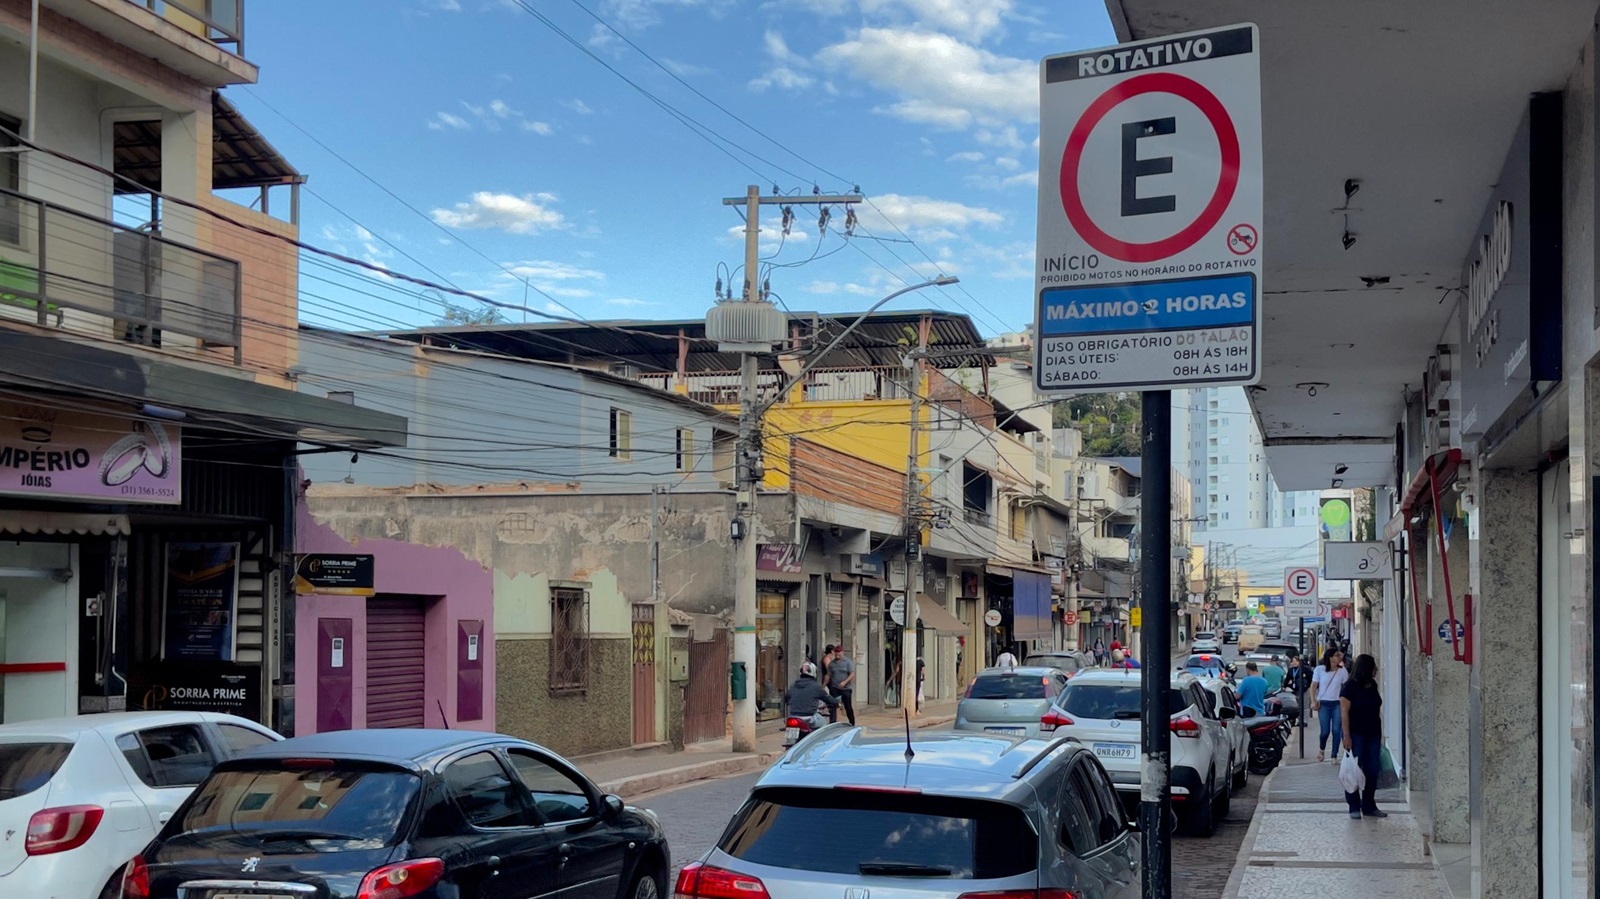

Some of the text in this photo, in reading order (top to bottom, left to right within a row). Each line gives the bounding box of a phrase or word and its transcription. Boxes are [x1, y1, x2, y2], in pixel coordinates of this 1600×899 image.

[1078, 37, 1213, 77] ROTATIVO
[1120, 116, 1177, 217] E
[1040, 258, 1257, 283] PROIBIDO MOTOS NO HORÁRIO DO ROTATIVO
[1044, 254, 1099, 272] INÍCIO
[1046, 291, 1247, 320] MÁXIMO 2 HORAS
[1047, 341, 1074, 353] USO
[1078, 335, 1172, 351] OBRIGATÓRIO
[1200, 328, 1248, 345] TALÃO
[1045, 355, 1075, 366] DIAS
[1173, 349, 1200, 360] 08H
[1225, 346, 1248, 357] 18H
[1045, 370, 1101, 382] SÁBADO:
[1172, 365, 1199, 376] 08H
[1225, 362, 1248, 373] 14H
[21, 474, 52, 487] JÓIAS
[121, 486, 175, 497] (31) 3561-5524
[1296, 575, 1307, 590] E
[170, 687, 247, 700] SORRIA PRIME
